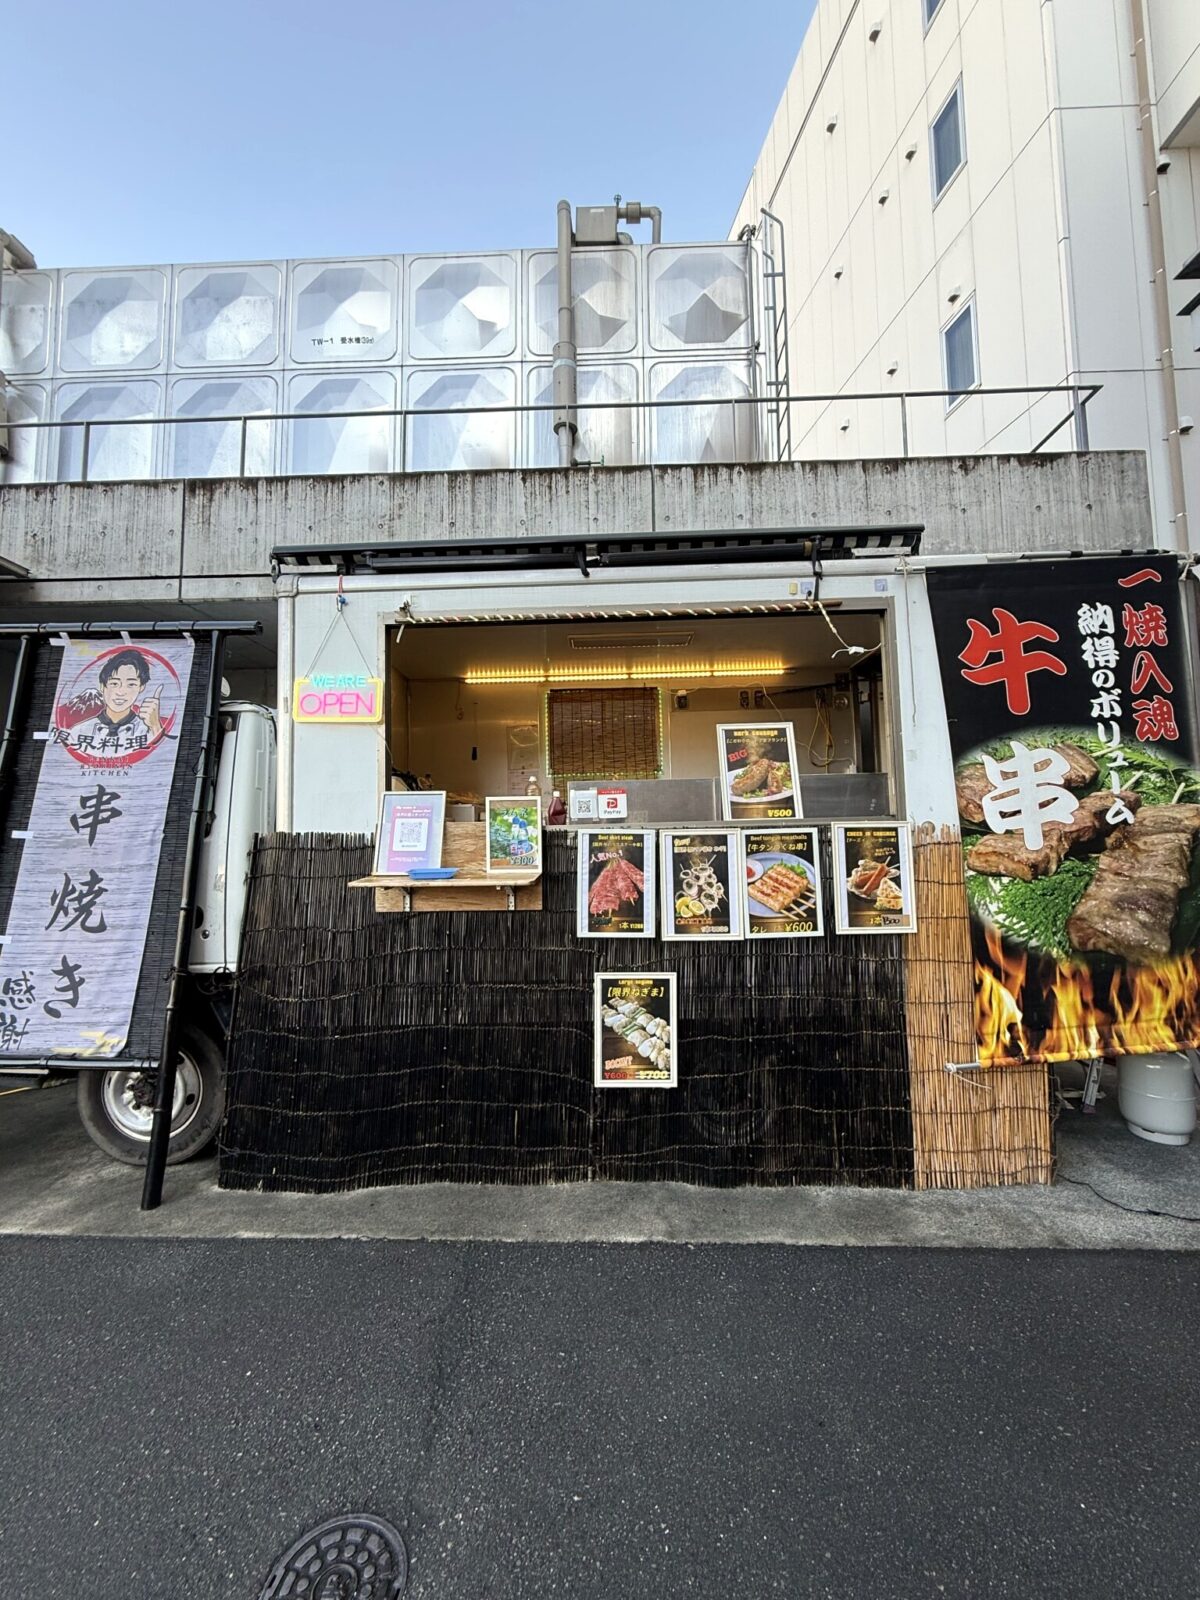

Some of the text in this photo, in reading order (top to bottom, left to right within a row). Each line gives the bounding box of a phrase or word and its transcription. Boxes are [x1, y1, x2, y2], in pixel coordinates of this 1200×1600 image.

[311, 337, 334, 346] TW-1
[1118, 568, 1180, 742] 一焼入魂
[312, 674, 367, 688] WE ARE
[299, 691, 374, 715] OPEN
[1077, 602, 1136, 825] 納得のボリューム
[50, 726, 179, 754] 限界料理人
[728, 749, 748, 762] BIG
[80, 769, 130, 777] KITCHEN
[767, 809, 793, 818] ¥500
[44, 783, 124, 1020] 串焼き
[784, 921, 814, 933] ¥600
